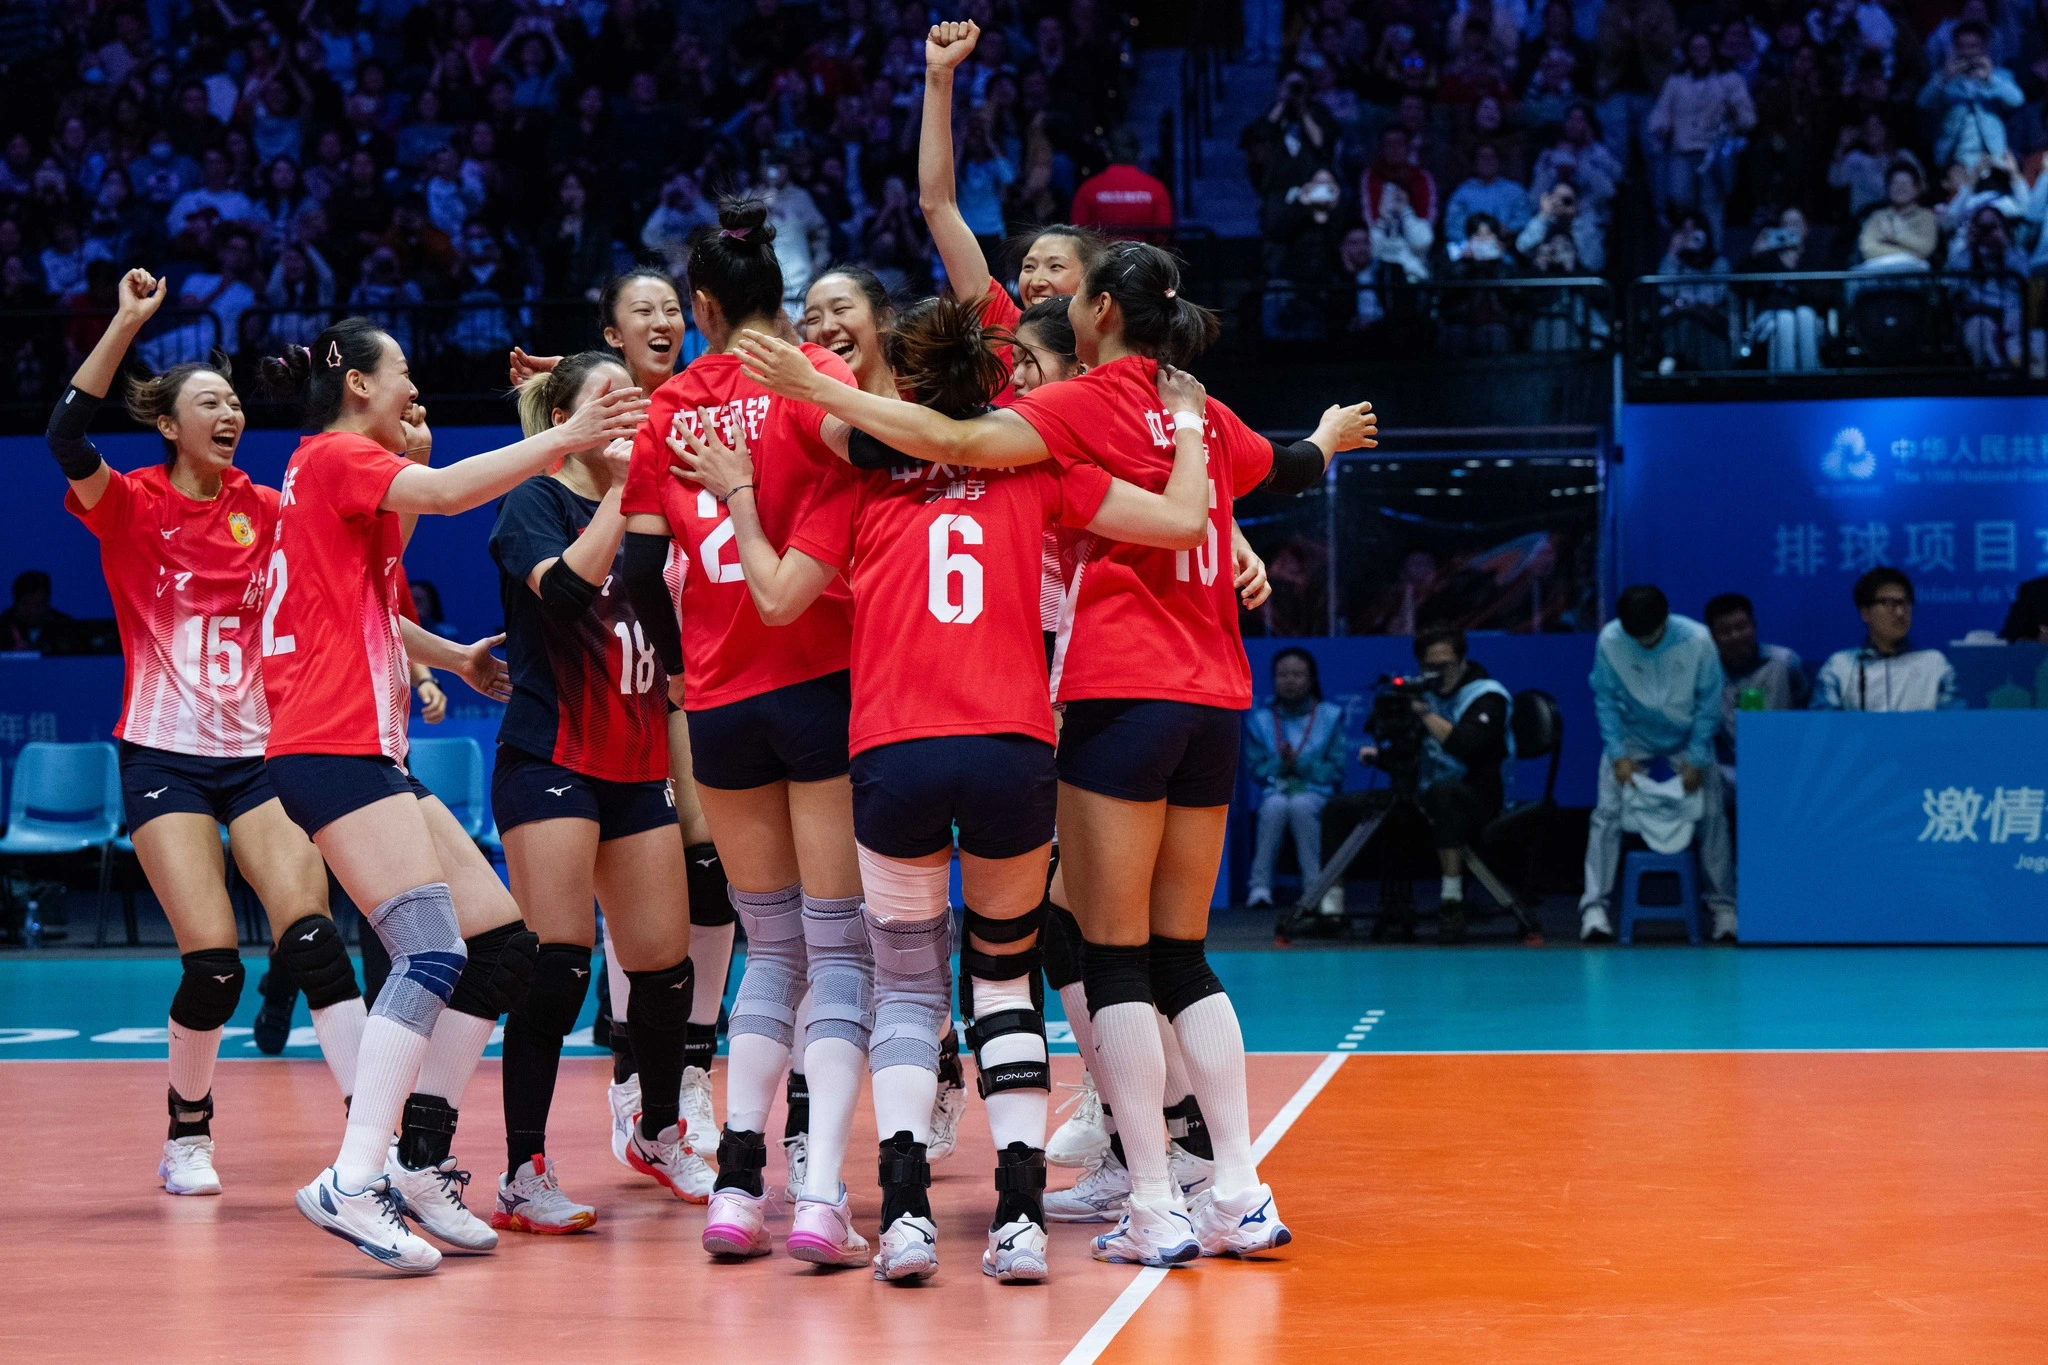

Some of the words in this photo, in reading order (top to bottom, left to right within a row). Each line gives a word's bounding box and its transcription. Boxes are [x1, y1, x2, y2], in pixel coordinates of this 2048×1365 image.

[1891, 435, 2048, 464] 中华人民共
[928, 514, 983, 624] 6
[1774, 520, 2048, 575] 排球项目
[185, 616, 242, 686] 15
[614, 620, 655, 695] 18
[1918, 786, 2048, 843] 激情
[996, 1071, 1040, 1082] DONJOY
